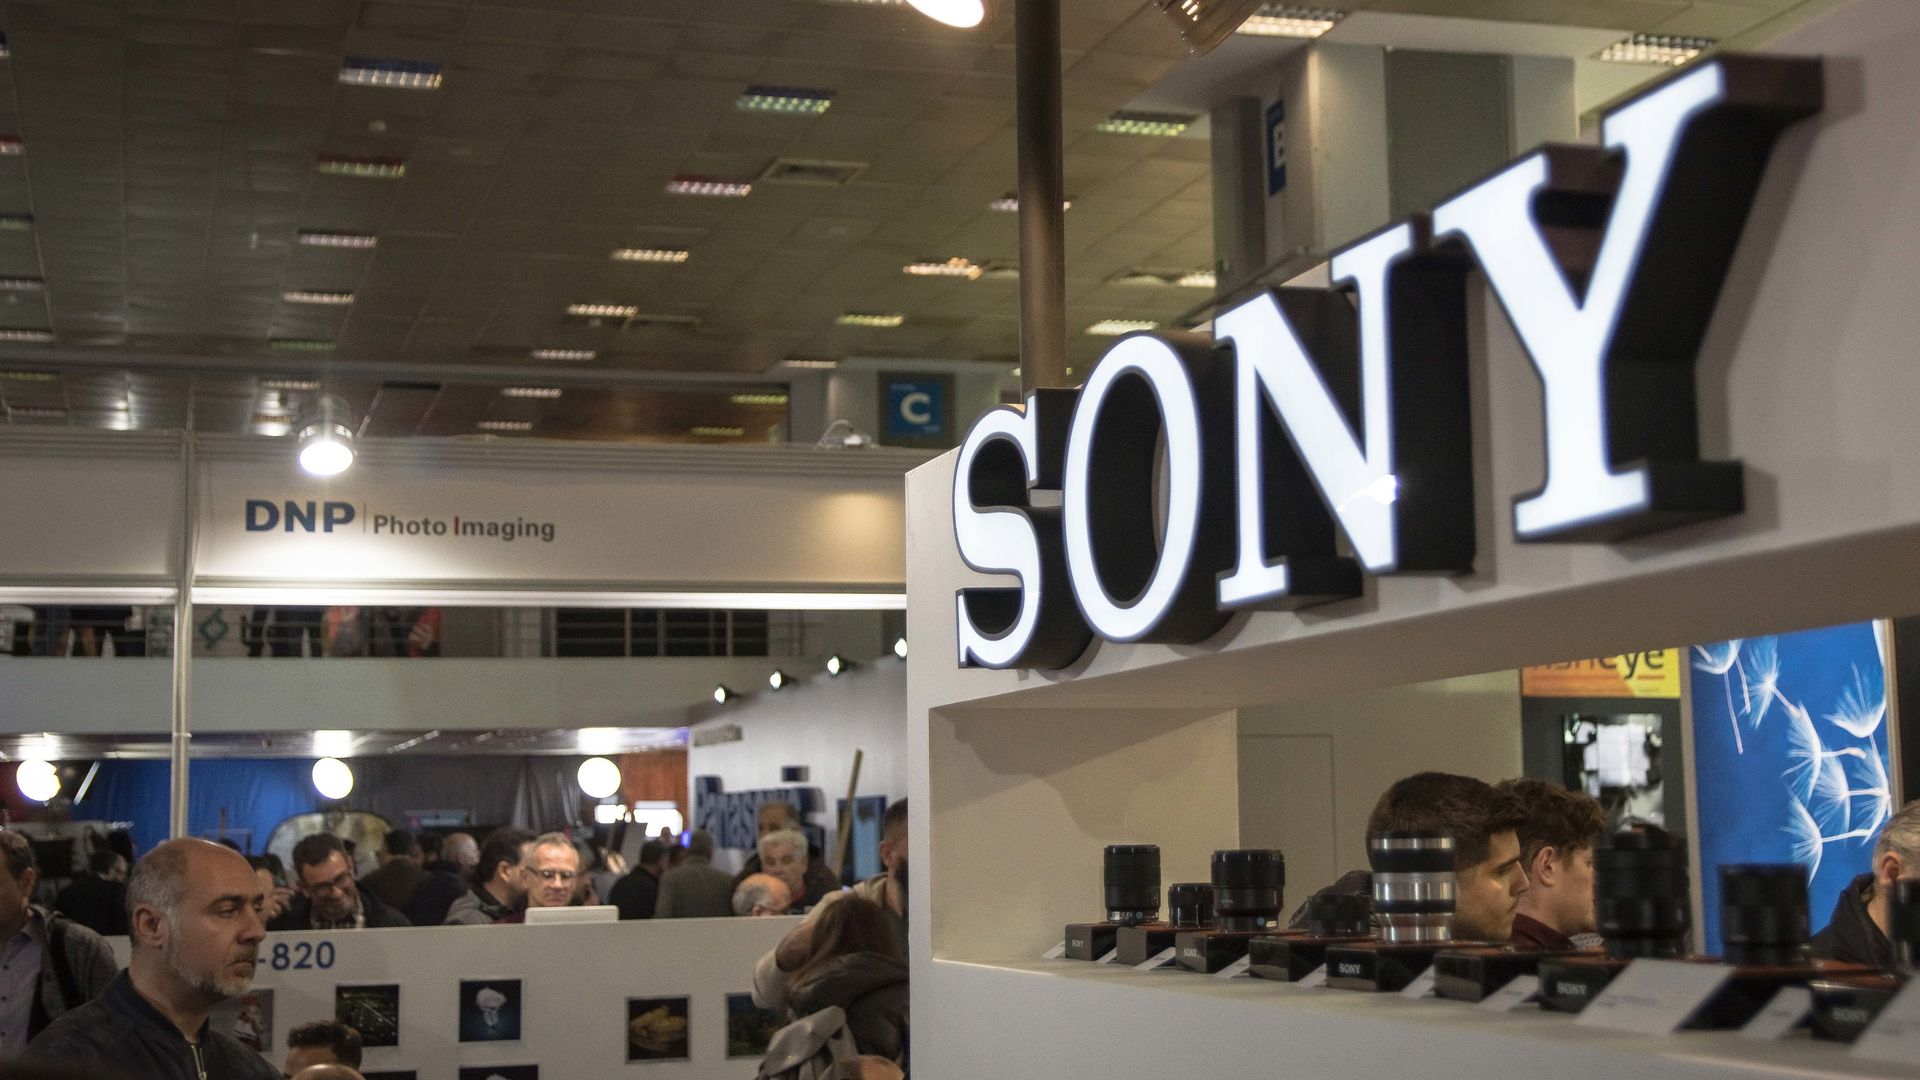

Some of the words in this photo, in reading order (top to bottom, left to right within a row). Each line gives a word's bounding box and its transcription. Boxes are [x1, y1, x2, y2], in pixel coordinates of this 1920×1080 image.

[952, 58, 1728, 669] SONY
[900, 392, 931, 425] C
[245, 499, 355, 532] DNP
[373, 514, 447, 536] Photo
[454, 516, 556, 542] Imaging
[1338, 963, 1361, 975] SONY
[1557, 982, 1587, 996] SONY
